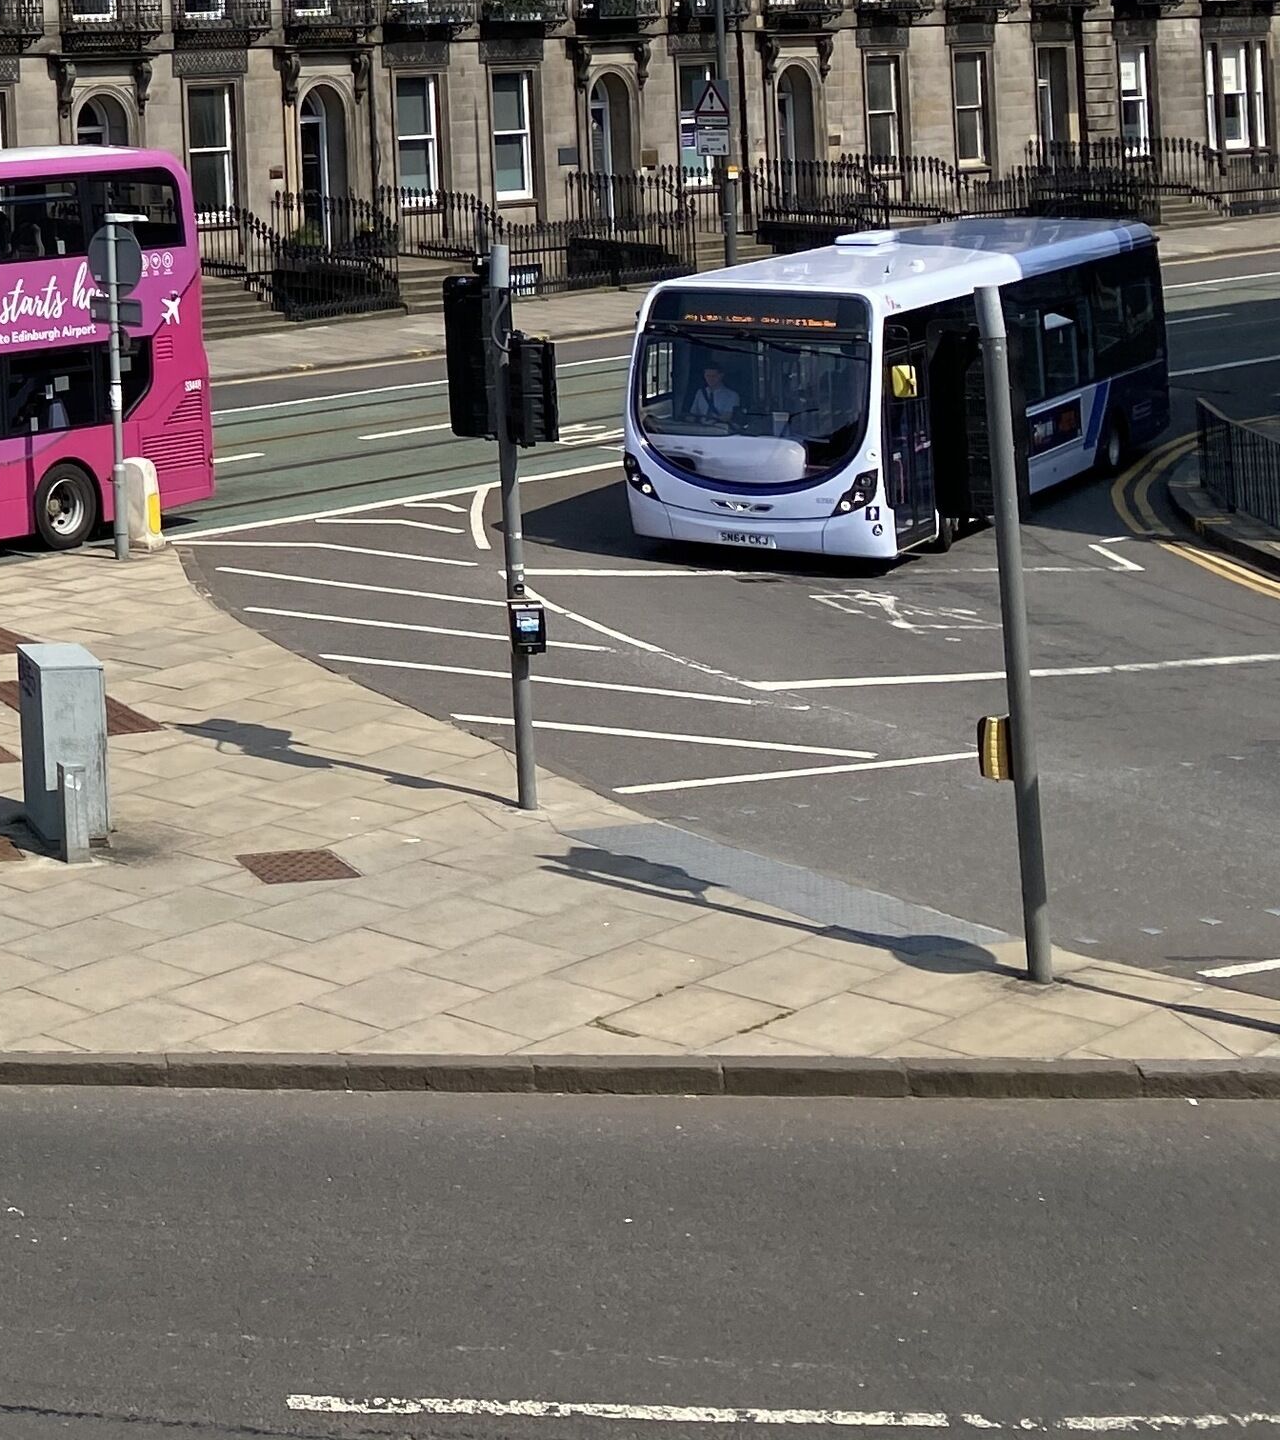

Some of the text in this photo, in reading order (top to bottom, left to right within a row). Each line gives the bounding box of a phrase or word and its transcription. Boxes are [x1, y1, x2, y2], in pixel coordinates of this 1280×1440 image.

[0, 275, 67, 325] starts
[0, 334, 10, 346] to
[12, 326, 61, 344] Edinburgh
[62, 324, 97, 338] Airport
[720, 532, 768, 546] SN64 CKJ
